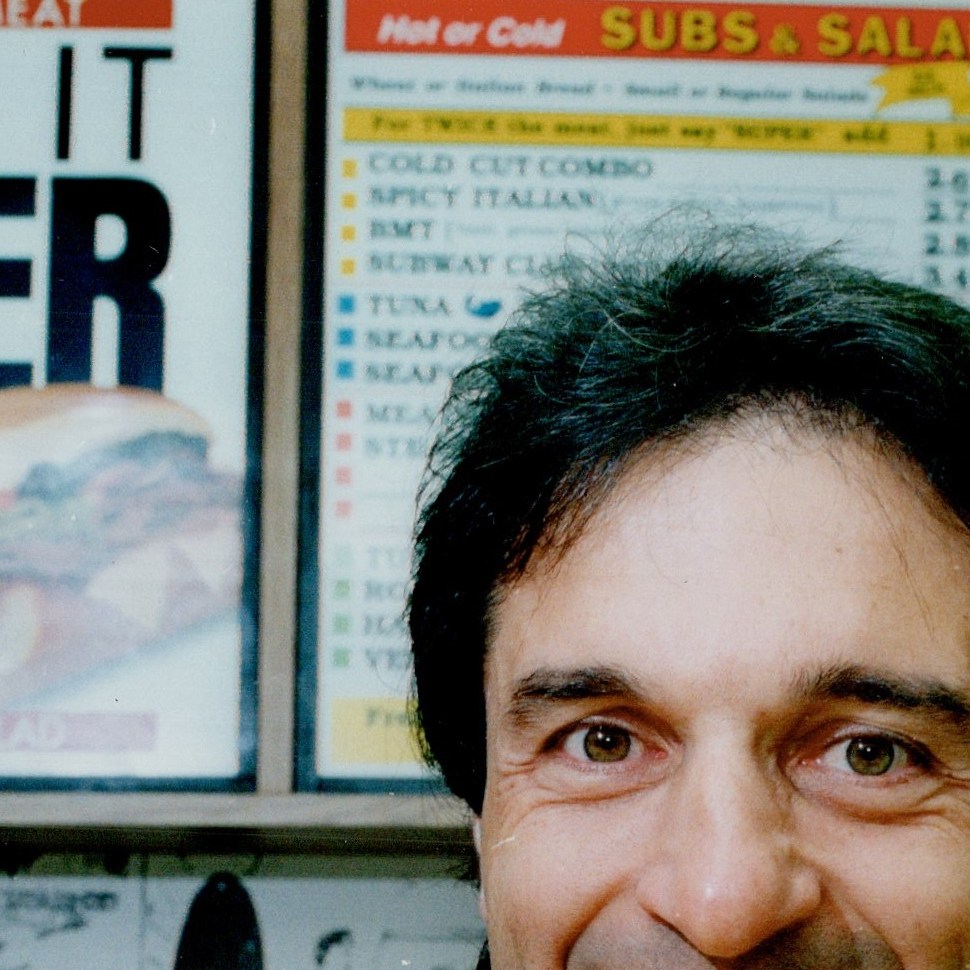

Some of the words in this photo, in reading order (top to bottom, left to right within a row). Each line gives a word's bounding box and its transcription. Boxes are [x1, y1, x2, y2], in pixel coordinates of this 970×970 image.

[0, 0, 84, 29] EAT
[377, 14, 440, 45] Hot
[443, 22, 483, 46] or
[486, 16, 566, 48] Cold
[601, 5, 761, 54] SUBS
[769, 23, 800, 56] &
[56, 45, 174, 161] IT
[368, 153, 454, 175] COLD
[469, 155, 529, 177] CUT
[538, 155, 654, 178] COMBO
[368, 186, 458, 209] SPICY
[473, 186, 596, 210] ITALIAN
[368, 218, 433, 240] BMT
[368, 252, 494, 276] SUBWAY
[368, 293, 452, 316] TUNA
